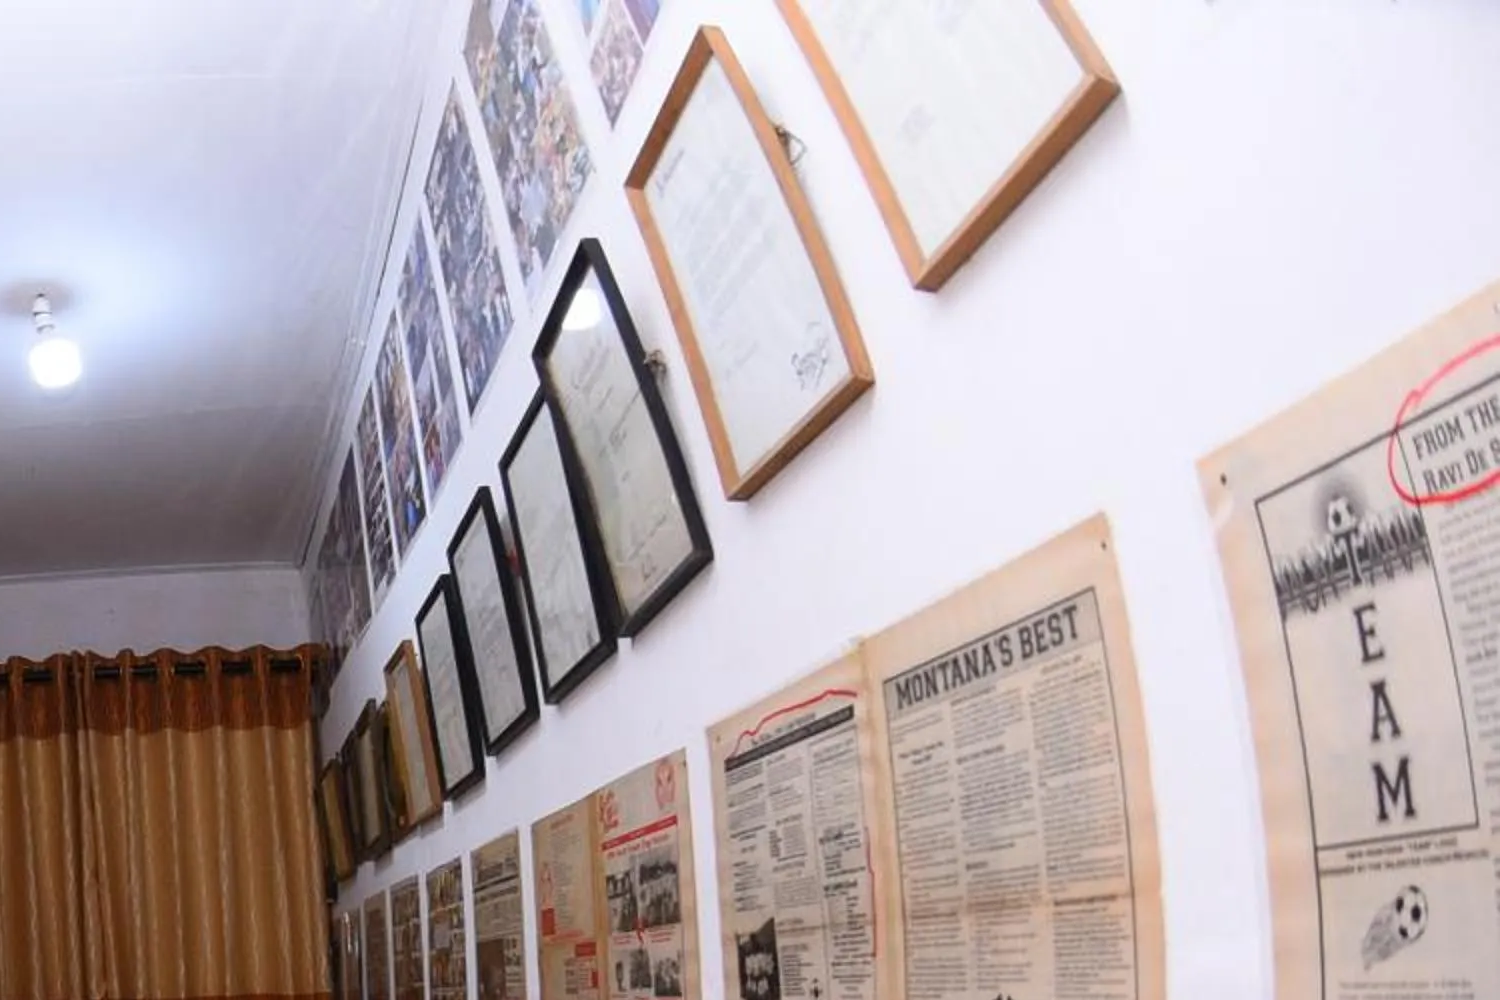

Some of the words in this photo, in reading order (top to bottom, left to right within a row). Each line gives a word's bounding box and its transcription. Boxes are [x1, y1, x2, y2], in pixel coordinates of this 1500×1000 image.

[1412, 415, 1466, 461] FROM
[1463, 394, 1500, 433] THE
[894, 634, 1015, 710] MONTANA'S
[1017, 604, 1079, 661] BEST
